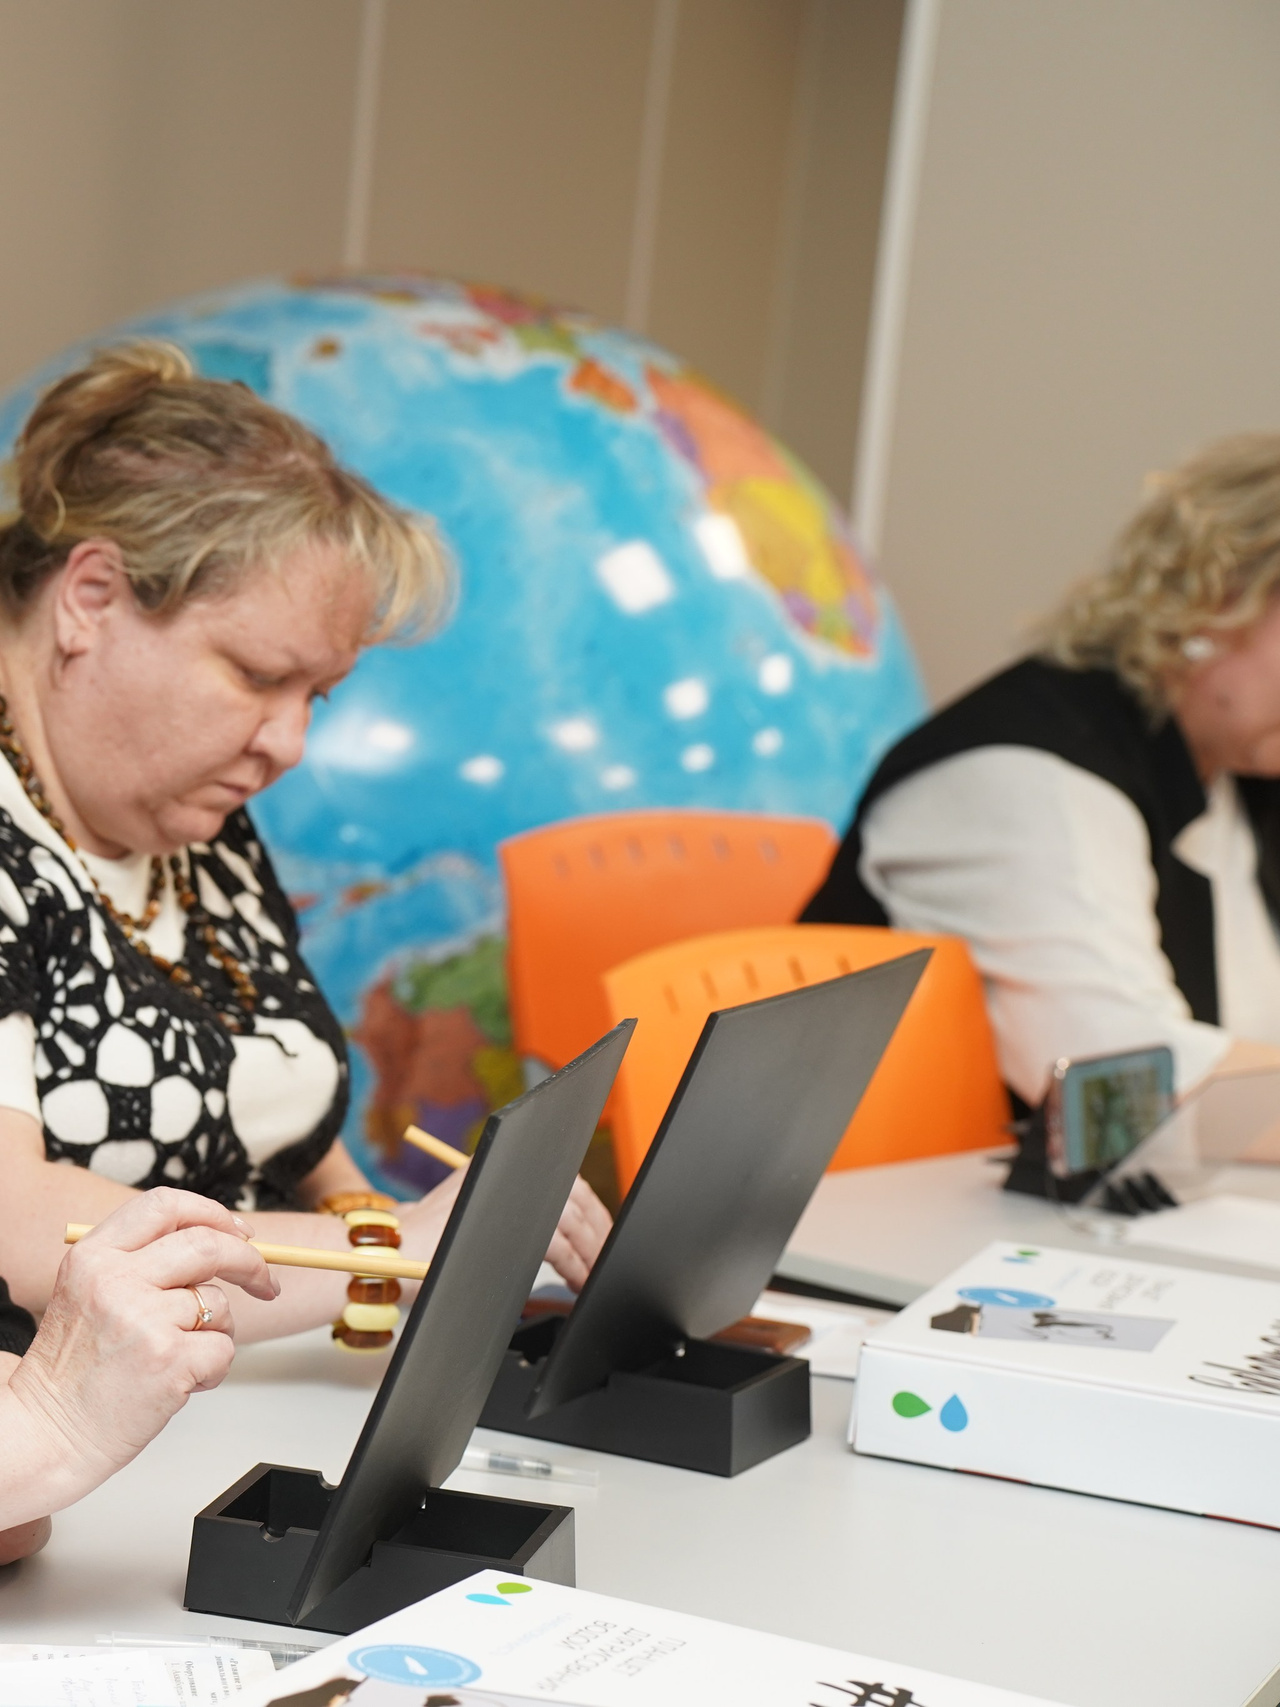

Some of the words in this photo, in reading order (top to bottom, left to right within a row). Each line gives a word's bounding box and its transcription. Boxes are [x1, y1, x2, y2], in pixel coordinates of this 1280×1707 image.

[558, 1619, 618, 1650] ВОДОЙ
[617, 1626, 652, 1648] ДЛЯ
[612, 1636, 687, 1678] ПЛАНШЕТ
